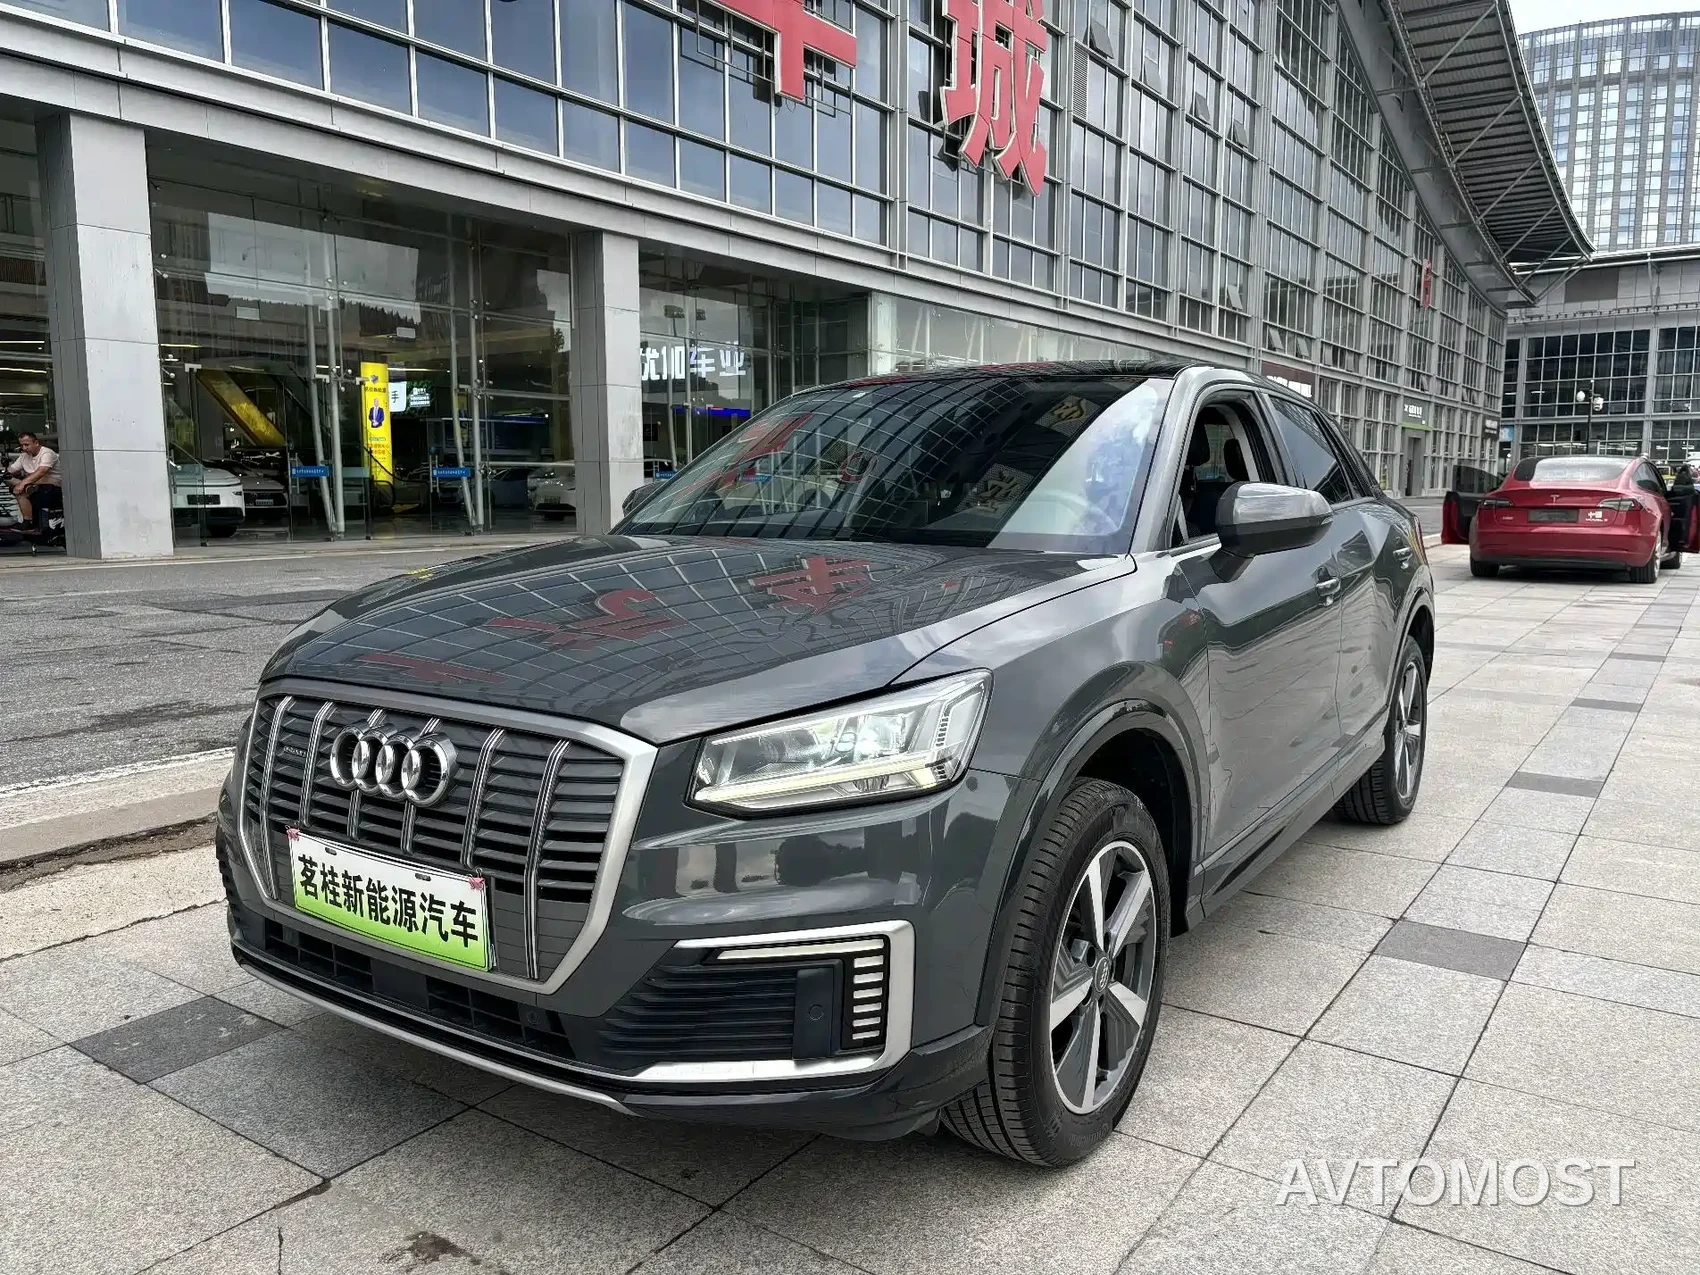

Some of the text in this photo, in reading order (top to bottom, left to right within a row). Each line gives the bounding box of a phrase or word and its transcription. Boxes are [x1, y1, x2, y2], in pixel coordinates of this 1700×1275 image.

[298, 854, 479, 948] 茗桂新能源汽车
